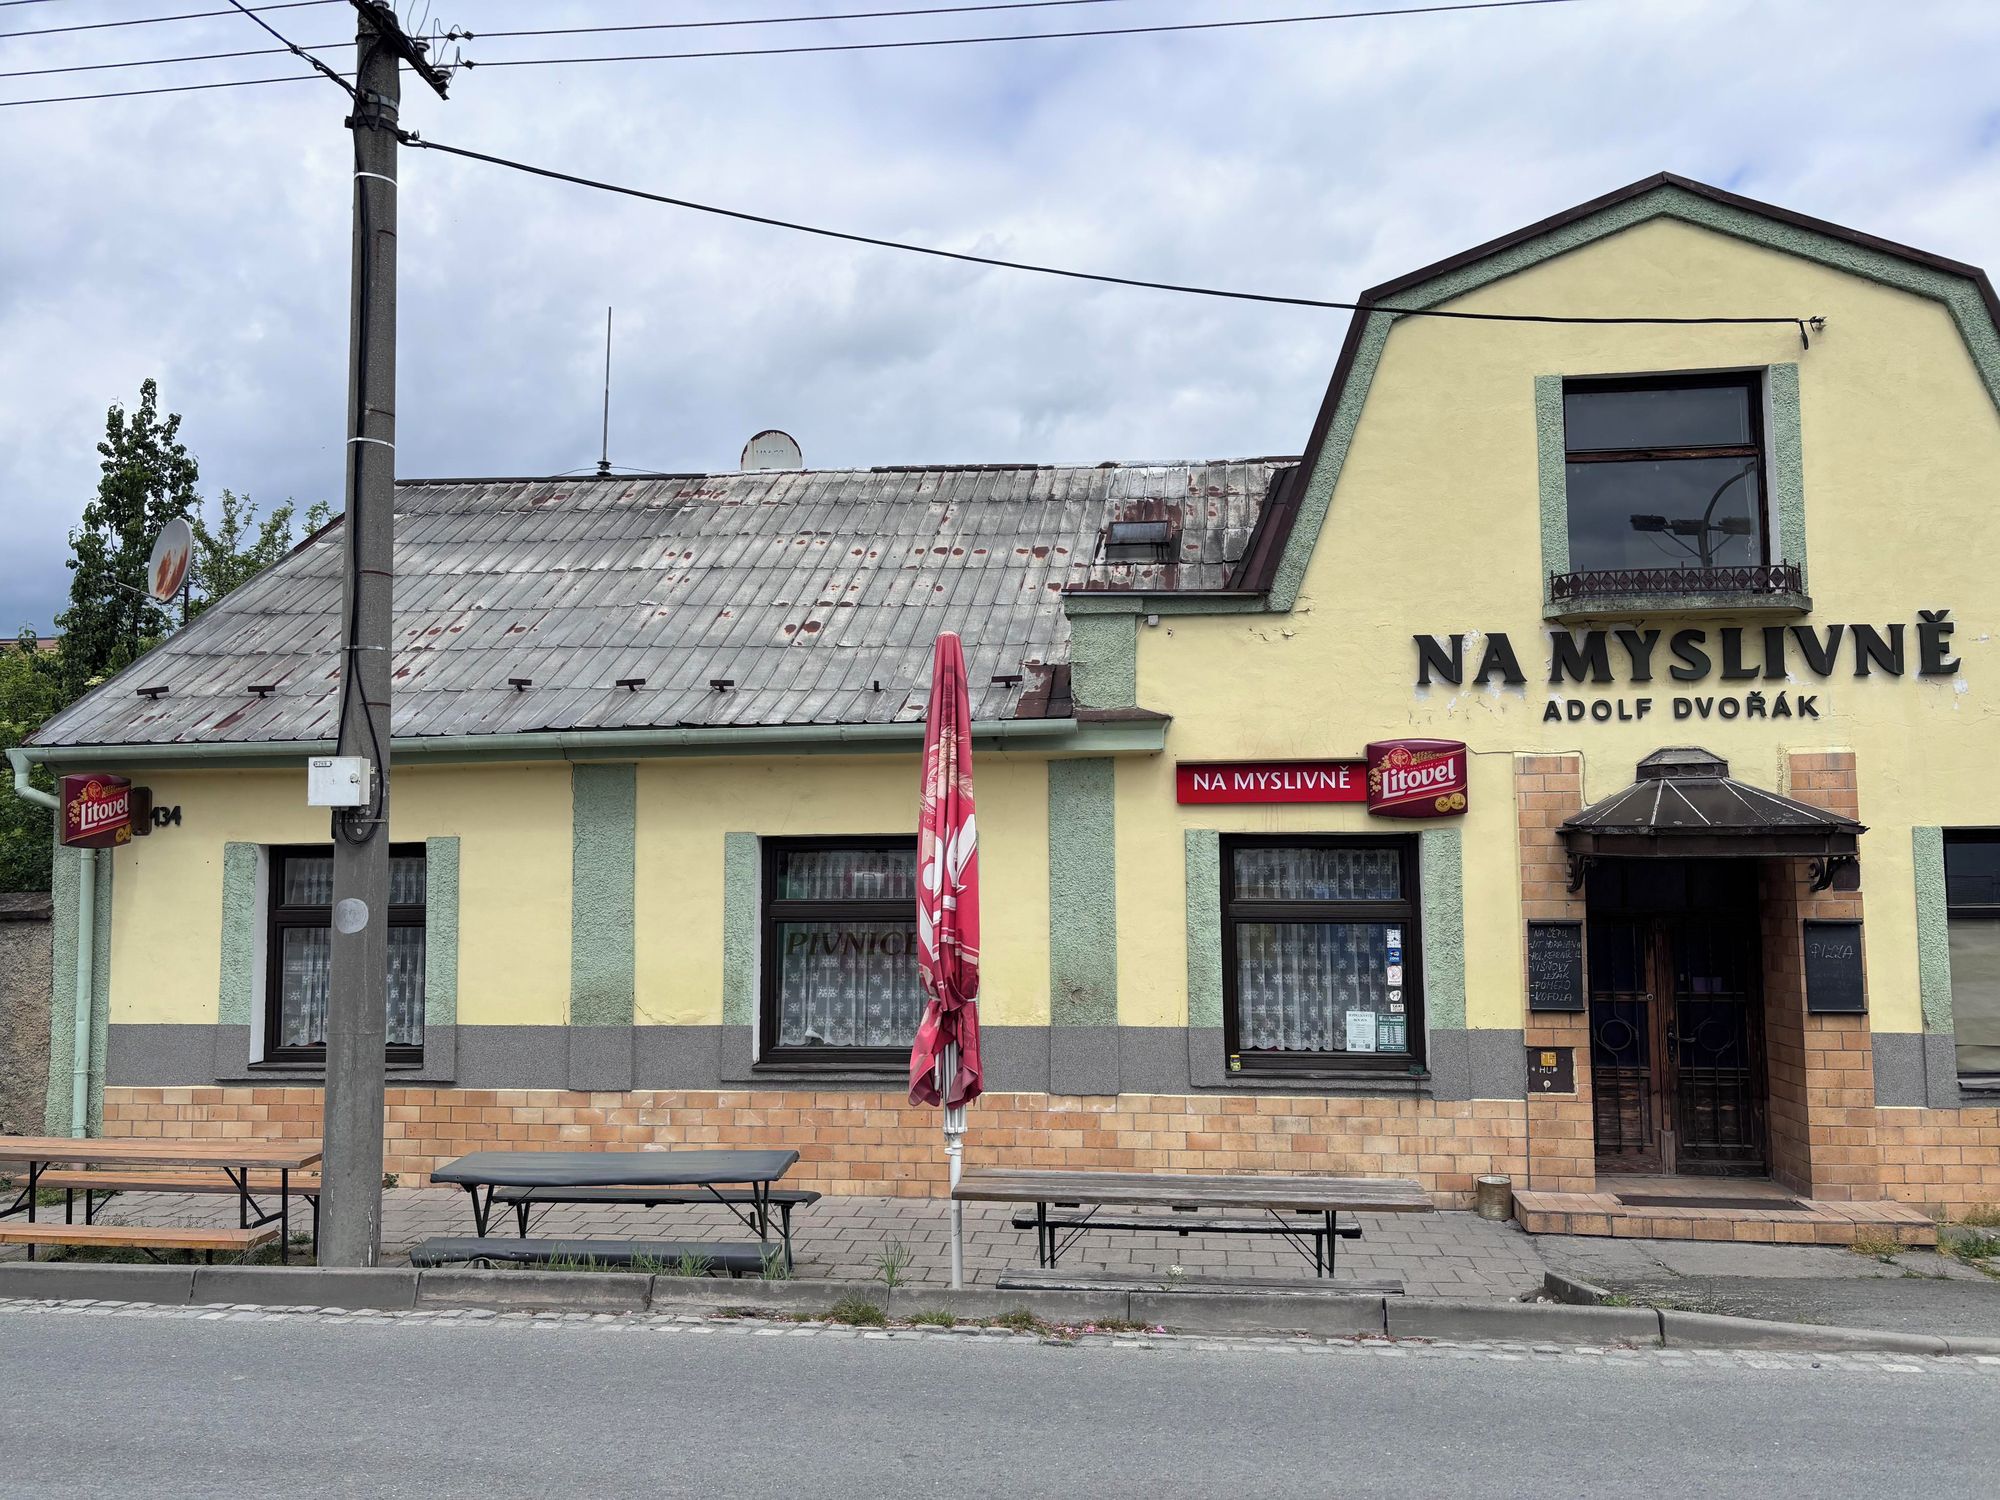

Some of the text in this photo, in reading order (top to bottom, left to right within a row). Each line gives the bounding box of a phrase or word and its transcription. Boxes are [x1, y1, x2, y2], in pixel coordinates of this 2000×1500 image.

[1412, 609, 1962, 684] NA MYSLIVNĚ
[1543, 691, 1819, 722] ADOLF DVOŘÁK
[1193, 766, 1351, 791] NA MYSLIVNĚ
[1382, 757, 1456, 799] Litovel
[80, 792, 130, 831] Litovel
[1809, 943, 1854, 959] PIZZA
